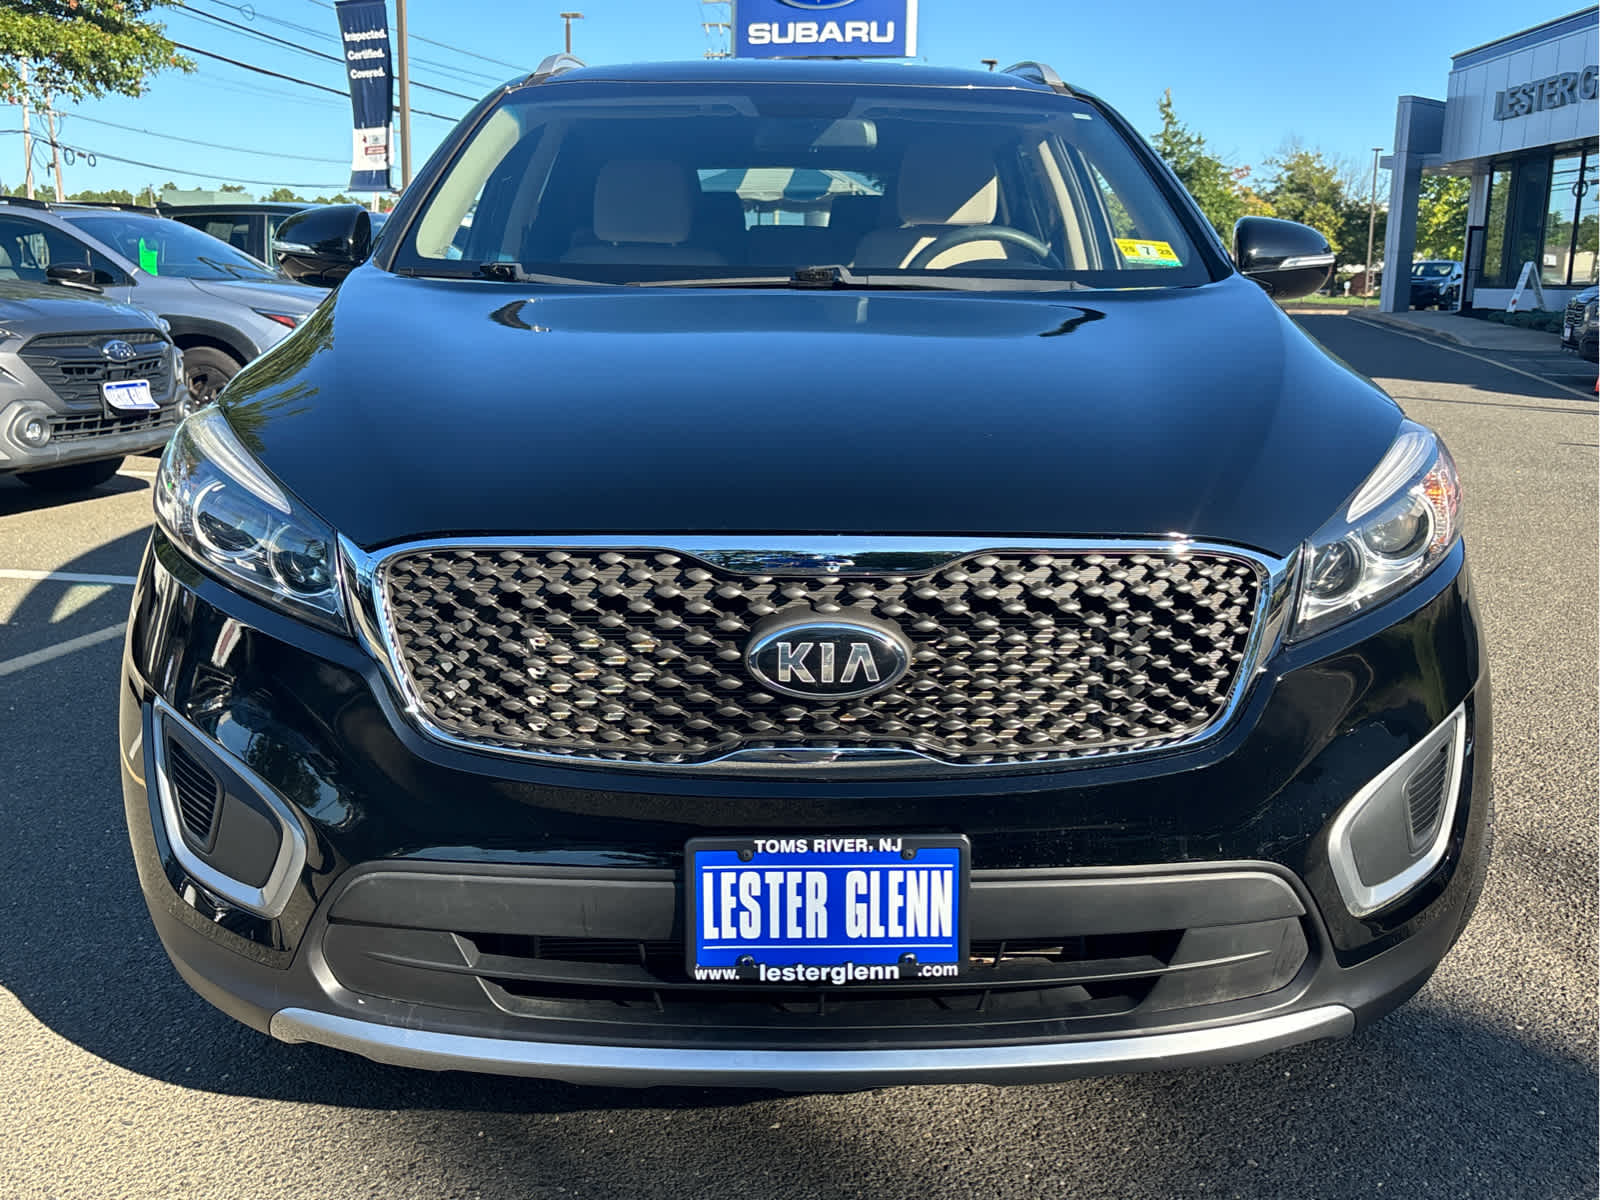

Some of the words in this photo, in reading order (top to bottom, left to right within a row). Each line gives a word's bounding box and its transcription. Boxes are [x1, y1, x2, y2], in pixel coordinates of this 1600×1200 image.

[344, 28, 387, 42] Inspected.
[748, 21, 895, 44] SUBARU
[347, 48, 385, 60] Certified.
[1493, 71, 1580, 121] LESTER
[776, 642, 881, 682] KIA
[754, 839, 808, 853] TOMS
[813, 838, 873, 853] RIVER,
[879, 838, 902, 852] NJ
[703, 871, 828, 940] LESTER
[845, 869, 953, 938] GLENN
[694, 967, 740, 980] www.
[759, 963, 900, 984] lesterglenn
[917, 964, 959, 977] .com
